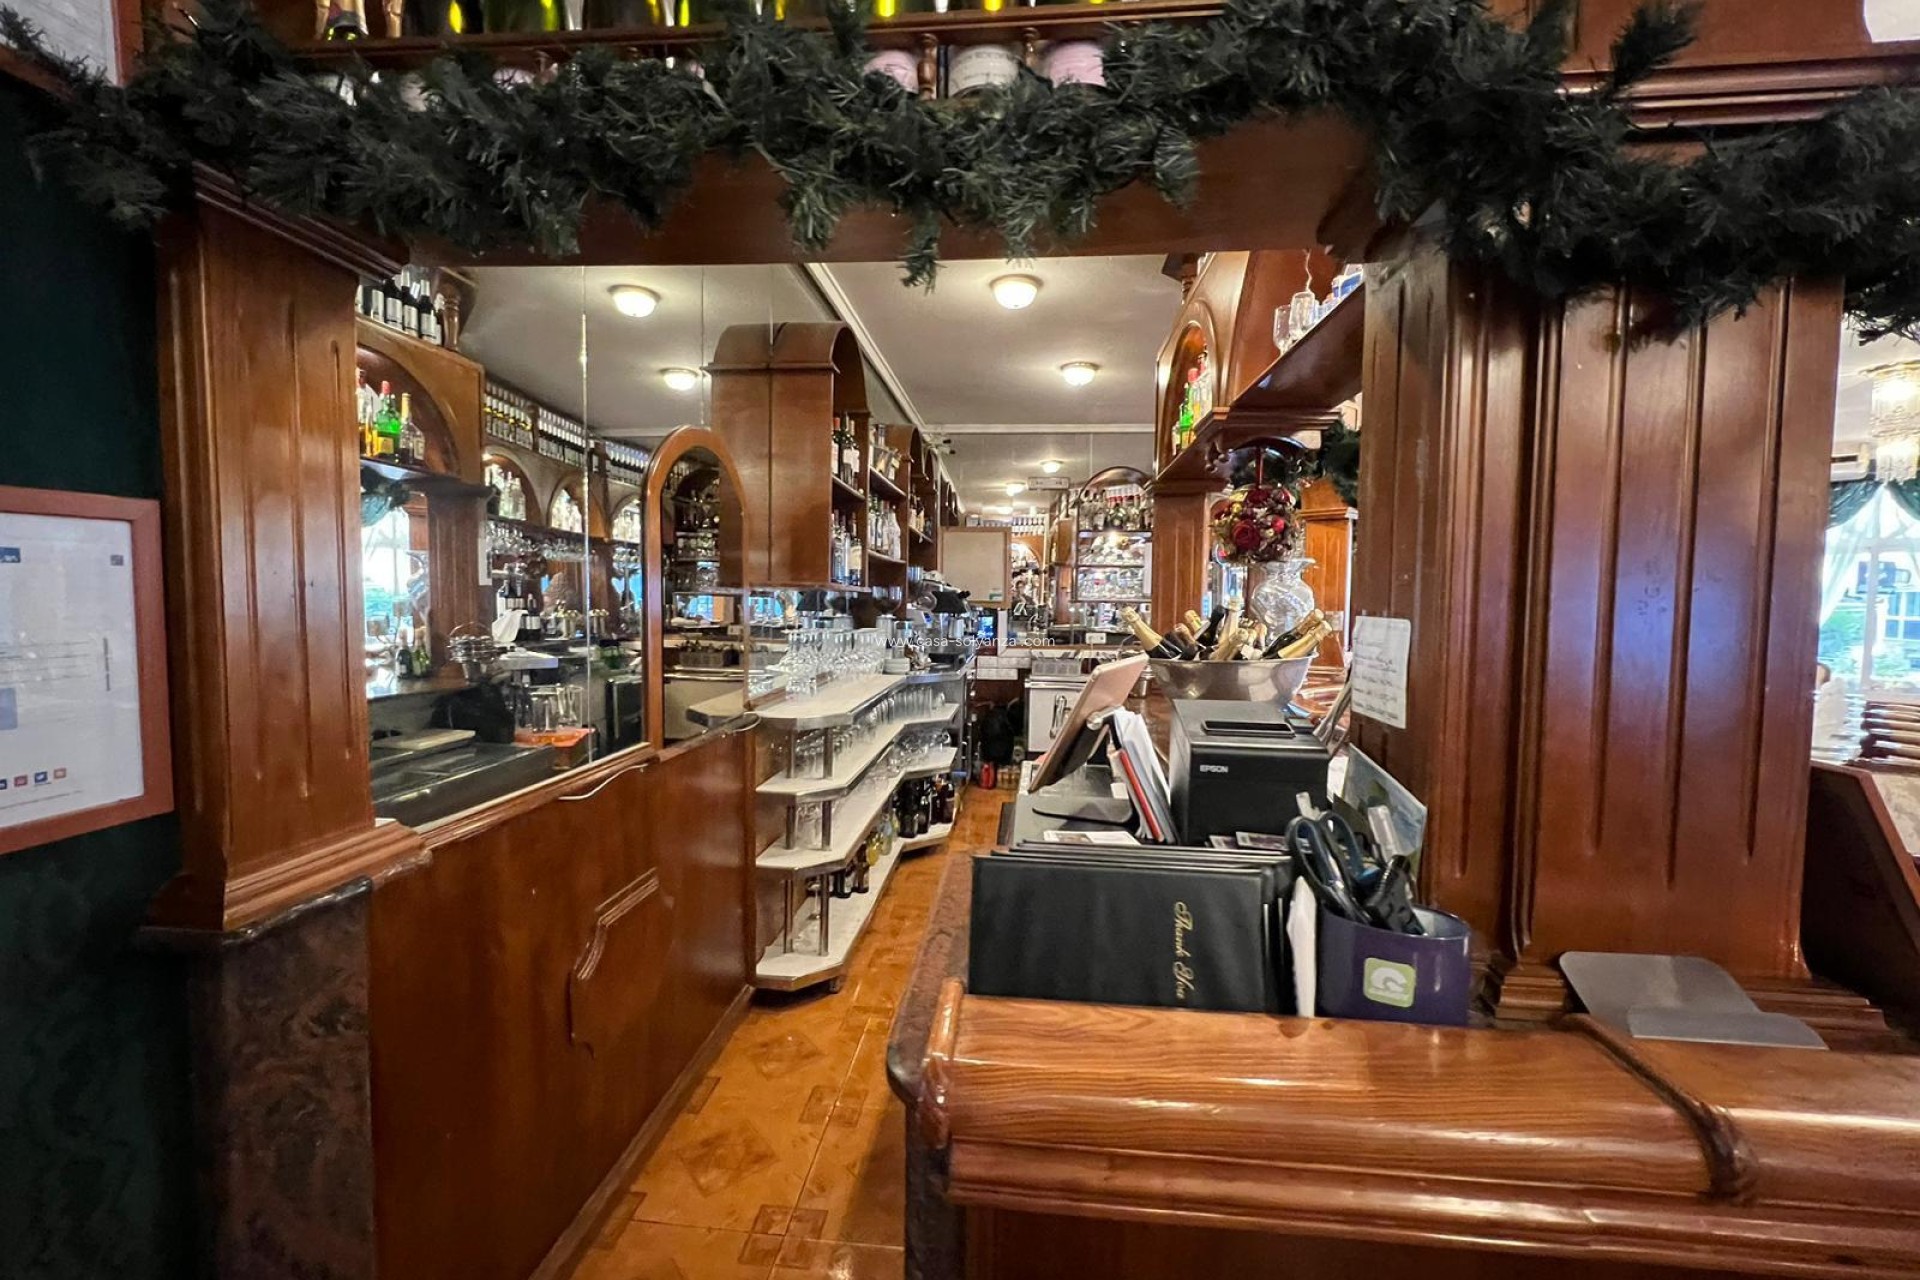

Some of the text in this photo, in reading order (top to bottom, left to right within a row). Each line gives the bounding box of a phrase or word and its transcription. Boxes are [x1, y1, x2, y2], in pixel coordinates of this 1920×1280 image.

[1199, 764, 1229, 773] EPSON
[1172, 901, 1195, 1000] Thank You
